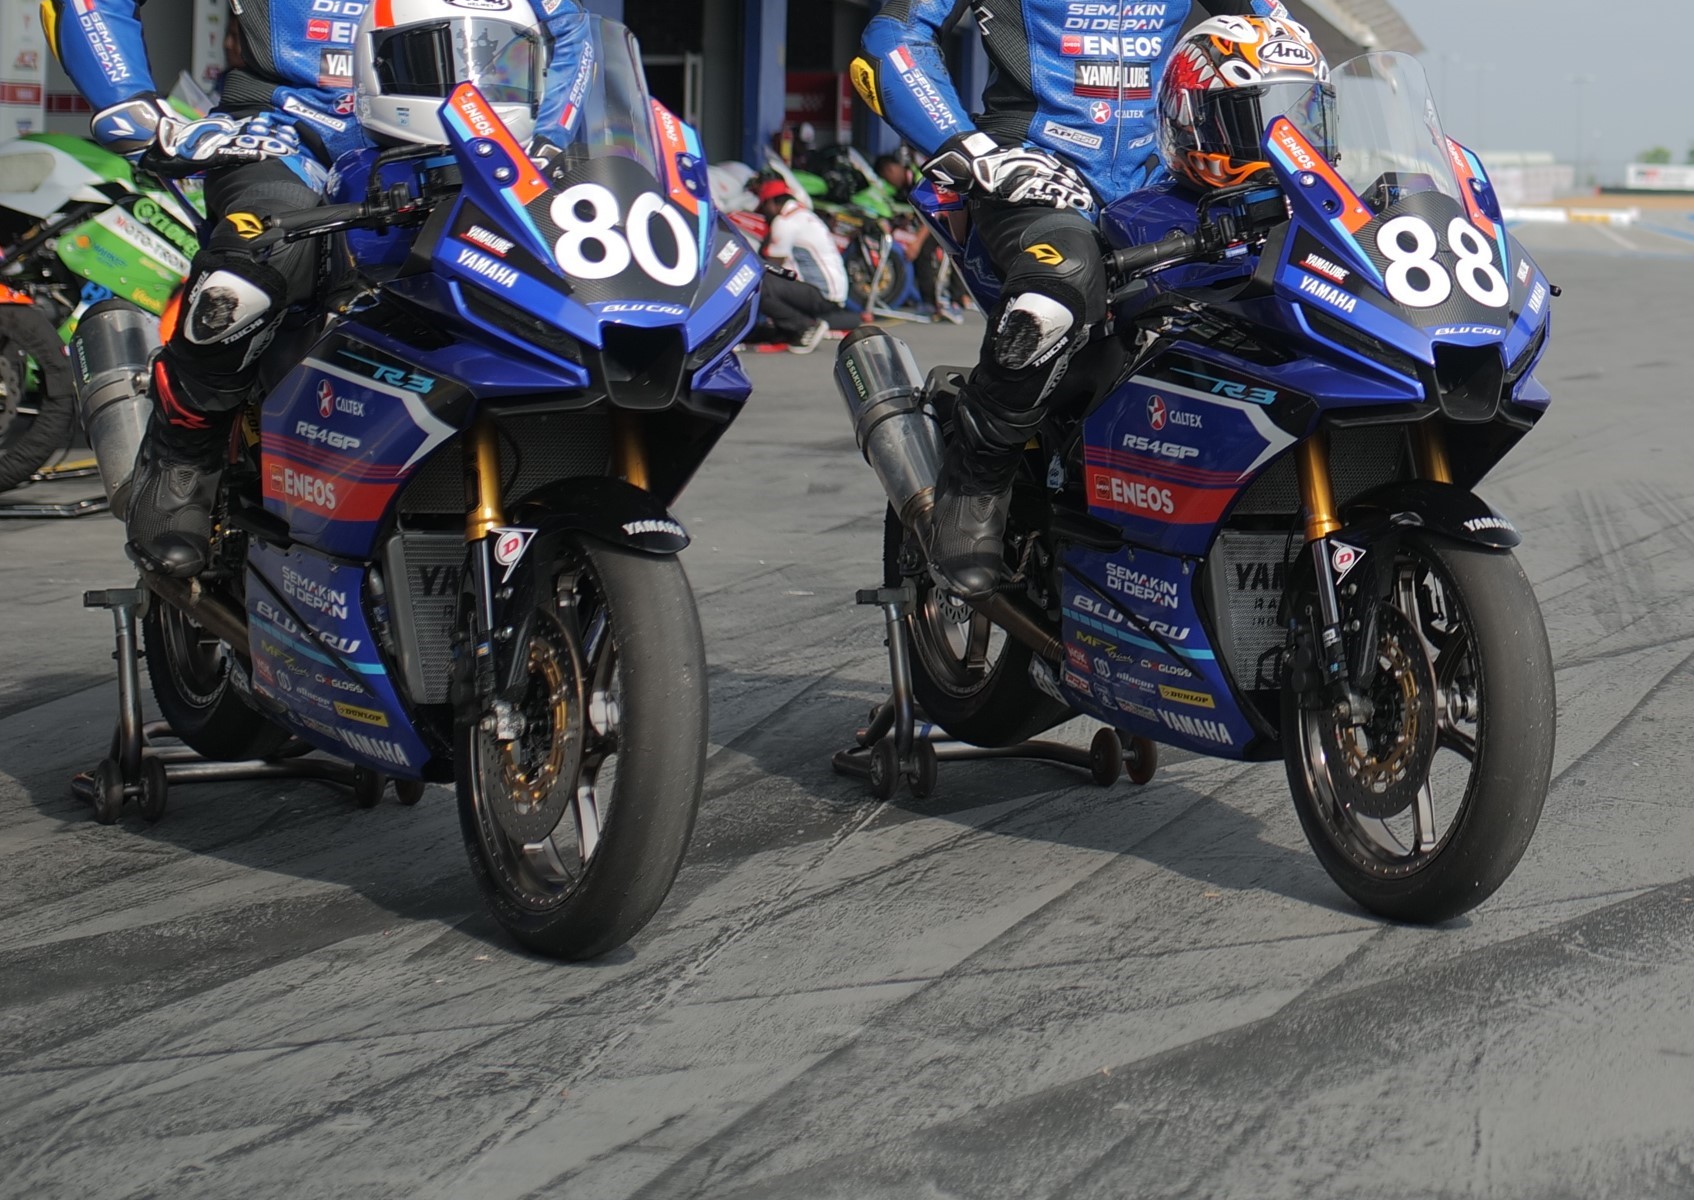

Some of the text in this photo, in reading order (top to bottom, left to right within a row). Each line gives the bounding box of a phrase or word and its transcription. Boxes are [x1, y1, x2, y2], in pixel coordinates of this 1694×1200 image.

[1091, 17, 1165, 31] DEPAN
[89, 11, 131, 79] SEMAKIN
[1083, 35, 1162, 57] ENEOS
[1270, 42, 1312, 60] Arai
[1079, 64, 1150, 88] YAMALUBE
[911, 68, 956, 125] SEMAKIN
[461, 101, 496, 138] ENEOS
[1113, 109, 1145, 119] CALTEX
[1282, 137, 1316, 170] ENEOS
[550, 183, 698, 287] 80
[456, 249, 520, 288] YAMAHA
[1303, 253, 1350, 281] YAMALUBE
[1376, 216, 1510, 307] 88
[1299, 275, 1357, 313] YAMAHA
[221, 318, 265, 345] TAICHI
[1434, 327, 1502, 336] BLU CRU
[1032, 337, 1069, 368] TAICHI
[848, 371, 868, 401] SAKURA
[336, 396, 366, 418] CALTEX
[1168, 408, 1203, 429] CALTEX
[296, 420, 361, 450] RS4GP
[1122, 433, 1200, 460] RS4GP
[284, 467, 337, 511] ENEOS
[1111, 477, 1175, 514] ENEOS
[621, 519, 687, 538] YAMAHA
[296, 587, 348, 621] DEPAN
[1125, 579, 1179, 609] DEPAN
[1169, 690, 1210, 704] DUNLOP
[345, 708, 383, 722] DUNLOP
[1156, 709, 1234, 745] YAMAHA
[336, 728, 412, 767] YAMAHA
